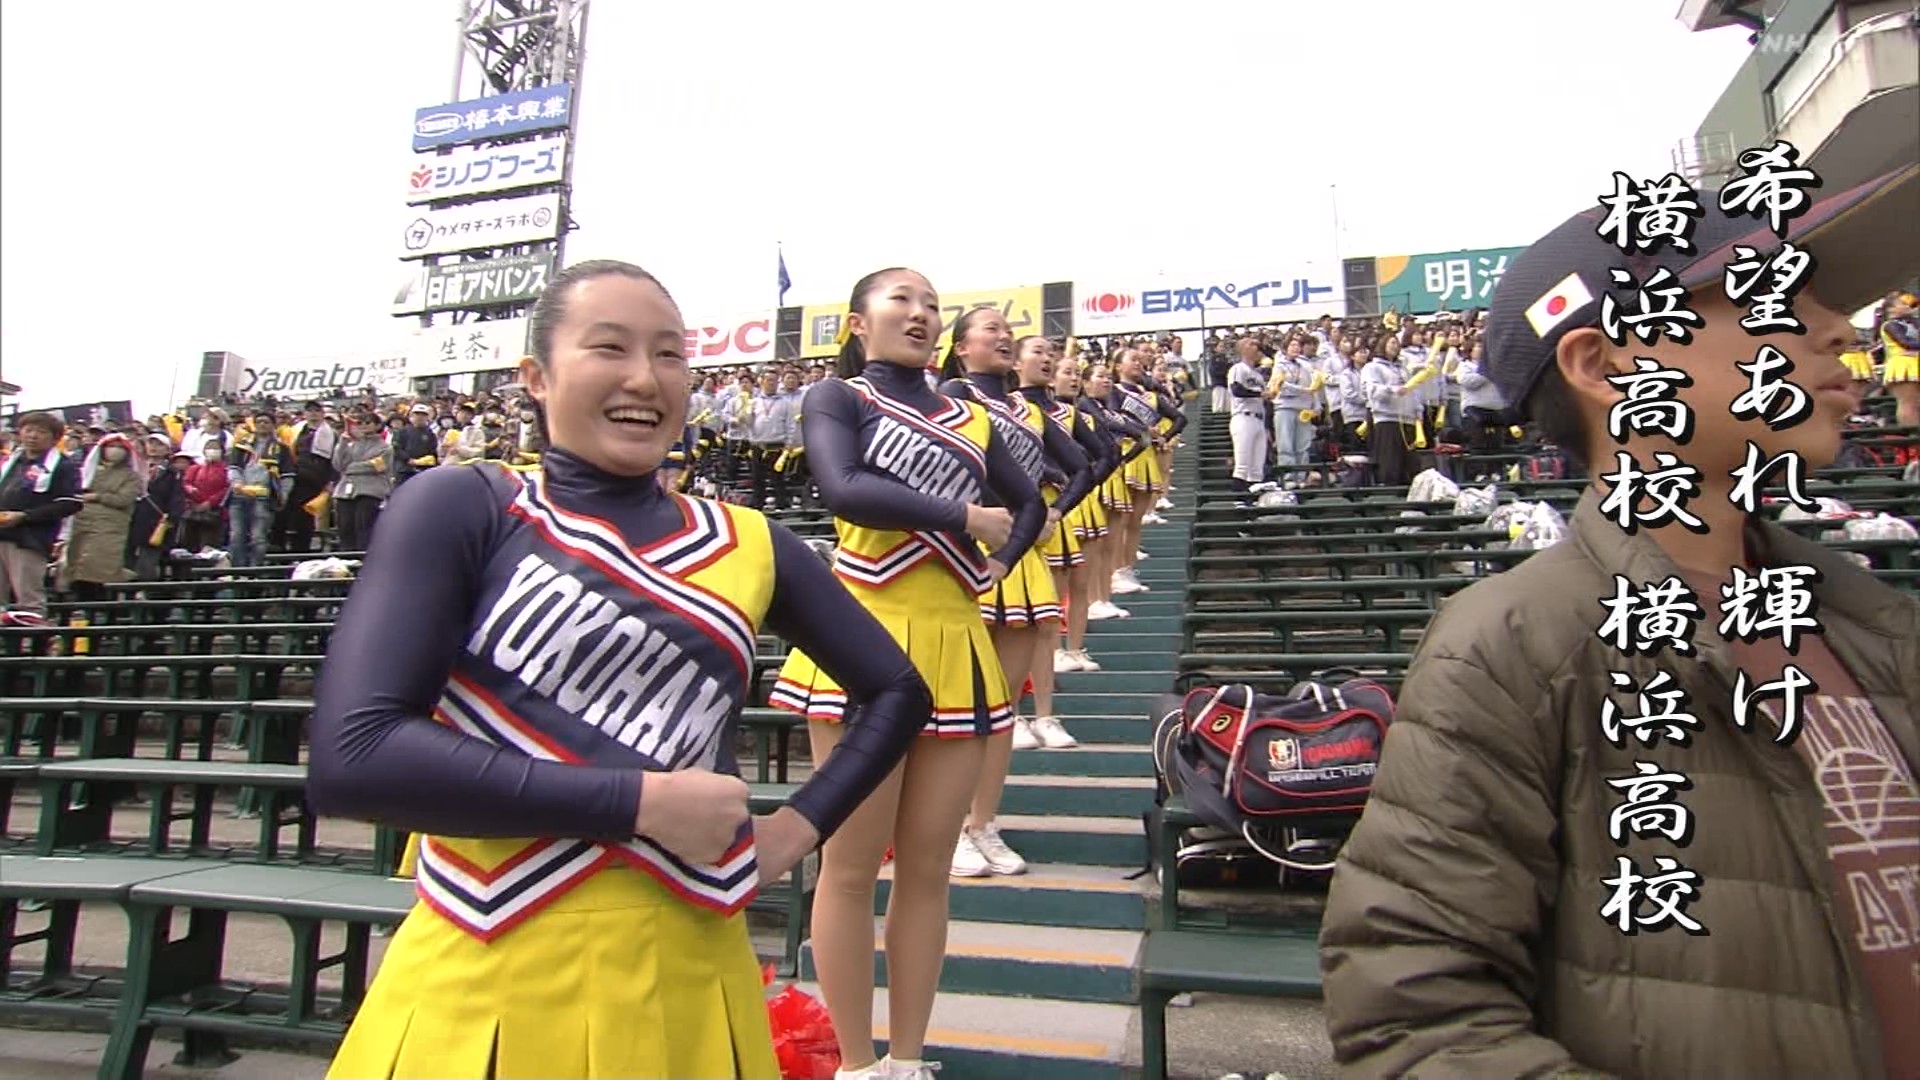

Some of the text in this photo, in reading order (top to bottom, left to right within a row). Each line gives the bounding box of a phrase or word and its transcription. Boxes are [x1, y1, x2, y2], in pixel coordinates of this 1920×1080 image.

[434, 146, 560, 189] シノブフーズ
[1142, 279, 1333, 314] 日本ペイント
[440, 331, 490, 362] 生茶
[240, 363, 366, 392] Yamato
